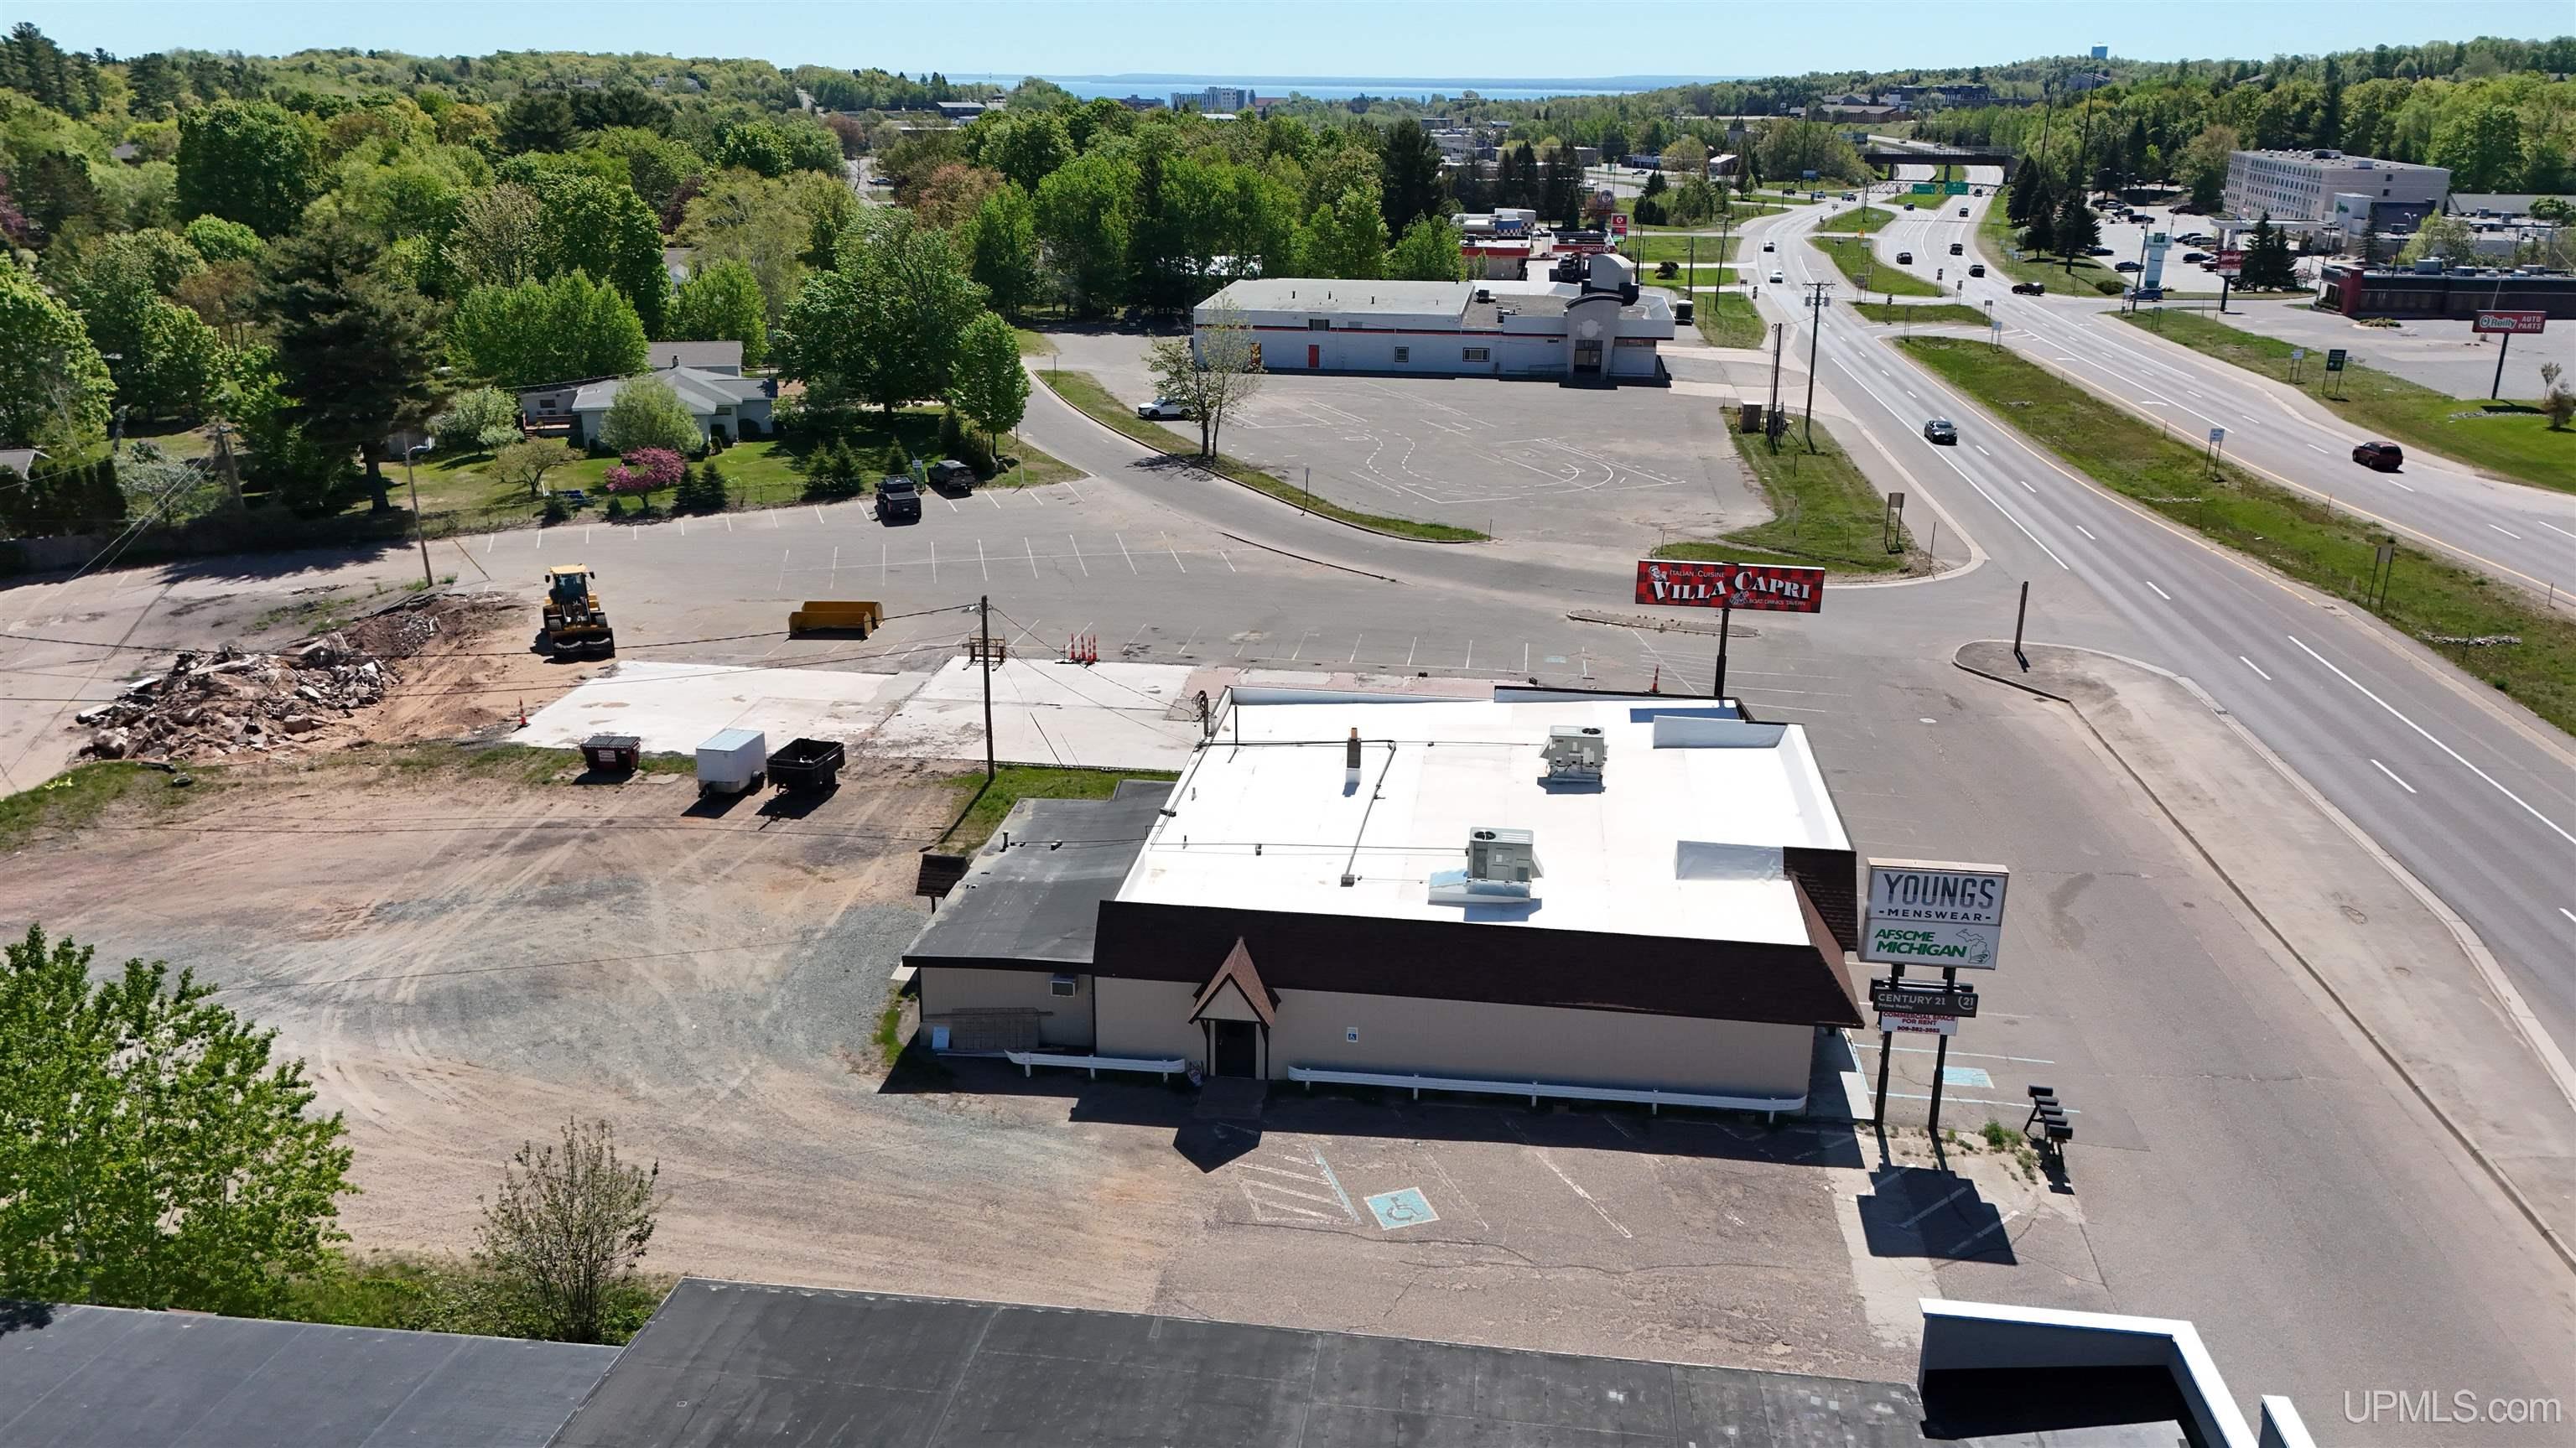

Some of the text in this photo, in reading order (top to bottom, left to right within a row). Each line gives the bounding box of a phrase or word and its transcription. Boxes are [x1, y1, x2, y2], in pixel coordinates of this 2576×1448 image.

[2480, 315, 2516, 330] O'Reilly
[1652, 580, 1727, 599] VILLA
[1734, 571, 1810, 599] CAPRI
[1884, 873, 1996, 910] YOUNGS
[1874, 928, 1935, 942] AFSCME
[1876, 941, 1967, 958] MICHIGAN
[1877, 994, 1945, 1005] CENTURY 21
[1963, 997, 1974, 1006] 21
[1883, 1011, 1931, 1020] COMMERCIAL
